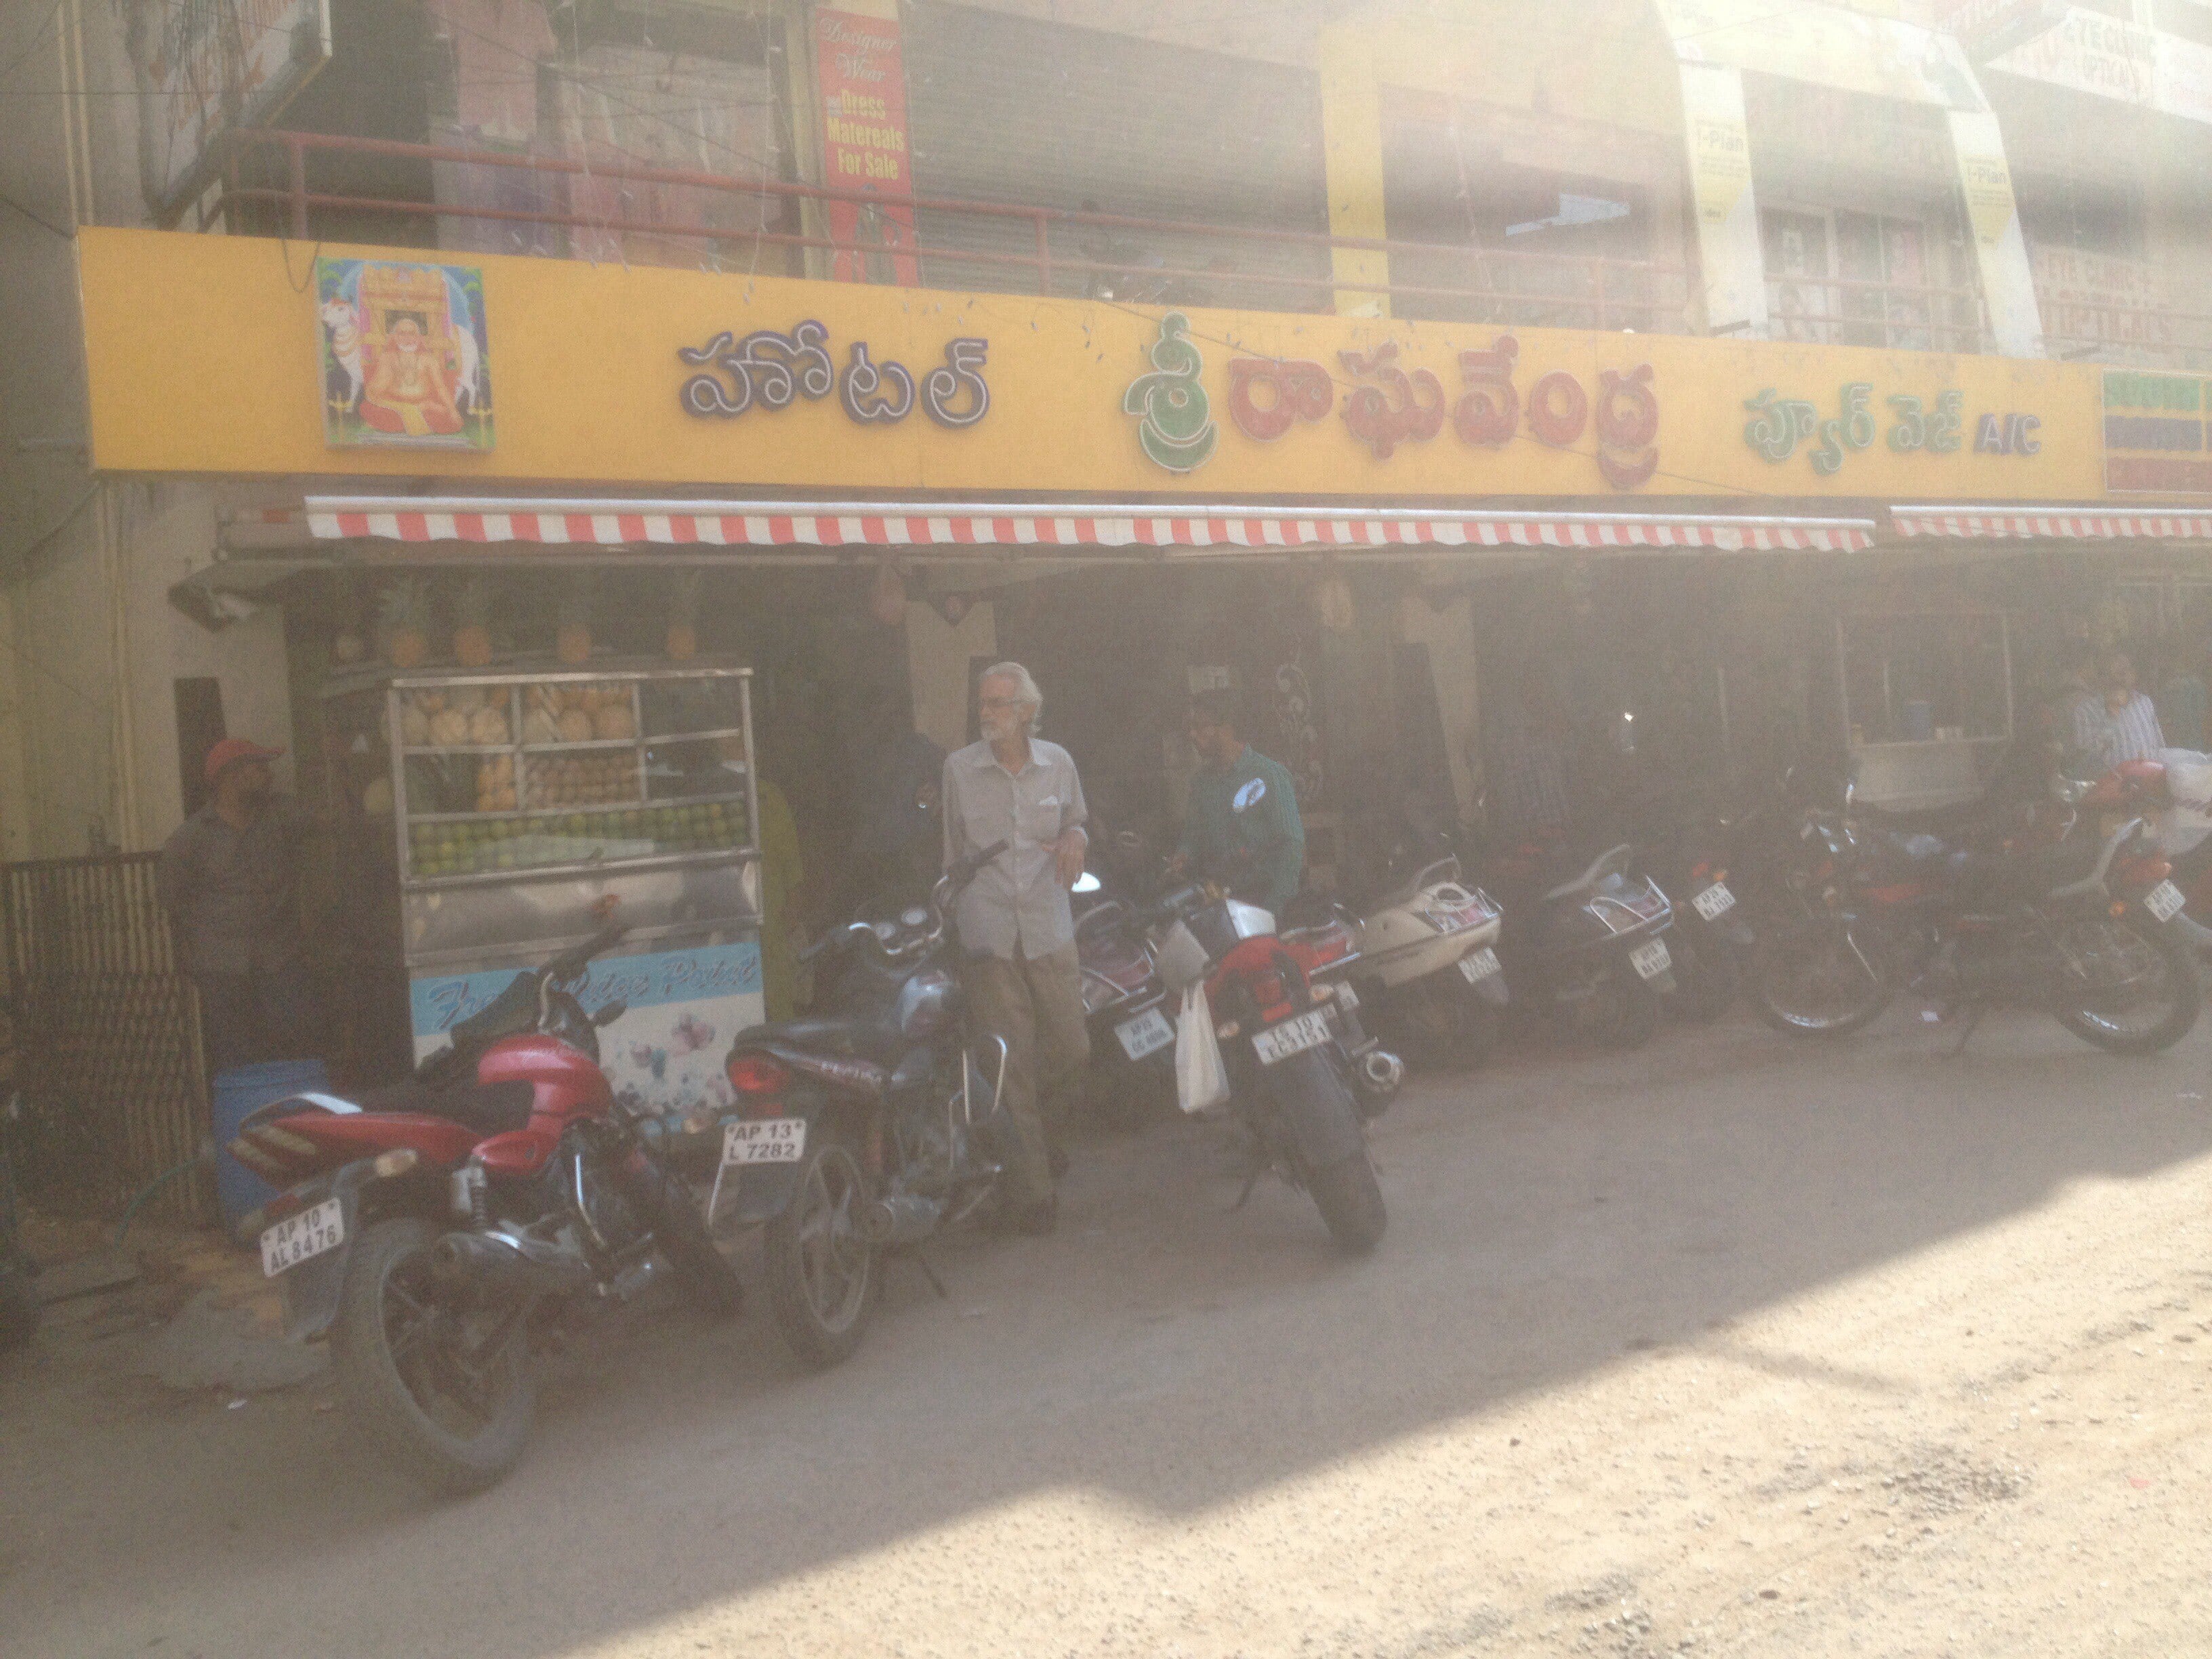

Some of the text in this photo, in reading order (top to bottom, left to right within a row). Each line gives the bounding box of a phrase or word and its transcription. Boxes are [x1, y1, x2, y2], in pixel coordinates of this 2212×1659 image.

[840, 89, 886, 120] Dress
[838, 147, 899, 180] For Sale
[678, 319, 991, 430] హోటల్
[1123, 310, 1218, 473] శ్రీ
[1227, 335, 1659, 490] రాఘవేంద్ర
[1973, 413, 2042, 457] A/C
[659, 951, 757, 996] Point
[733, 1122, 792, 1141] AP 13
[729, 1141, 796, 1160] L 7282
[276, 1208, 321, 1246] AP 10
